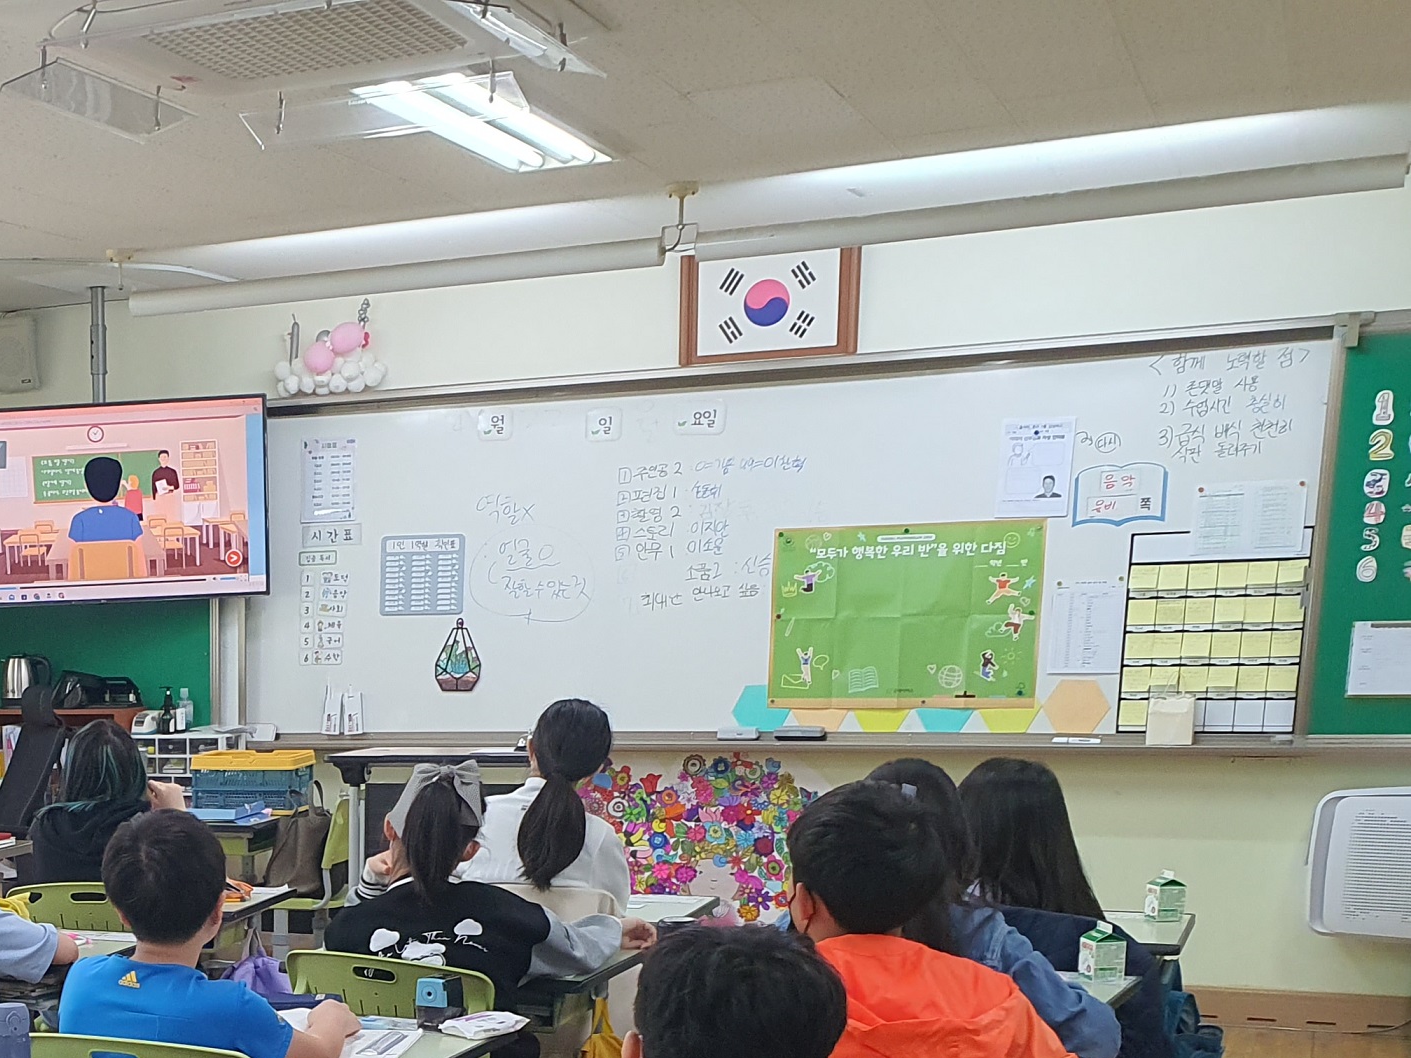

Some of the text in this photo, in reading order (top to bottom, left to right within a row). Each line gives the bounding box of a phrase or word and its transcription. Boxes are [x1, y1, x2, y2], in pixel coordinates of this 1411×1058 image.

[1226, 351, 1267, 371] 노력할
[1185, 379, 1223, 397] 존댓말
[1234, 376, 1260, 393] 사용
[1182, 396, 1232, 417] 수업시간
[1374, 391, 1392, 422] 1
[490, 415, 505, 435] 월
[598, 416, 613, 435] 일
[691, 410, 717, 428] 요일
[1369, 429, 1394, 461] 2
[1140, 497, 1152, 511] 쪽
[1361, 527, 1380, 551] 5
[852, 546, 888, 560] 행복한
[891, 545, 913, 557] 우리
[952, 542, 977, 556] 위한
[981, 541, 1006, 555] 다짐
[1357, 556, 1377, 580] 6
